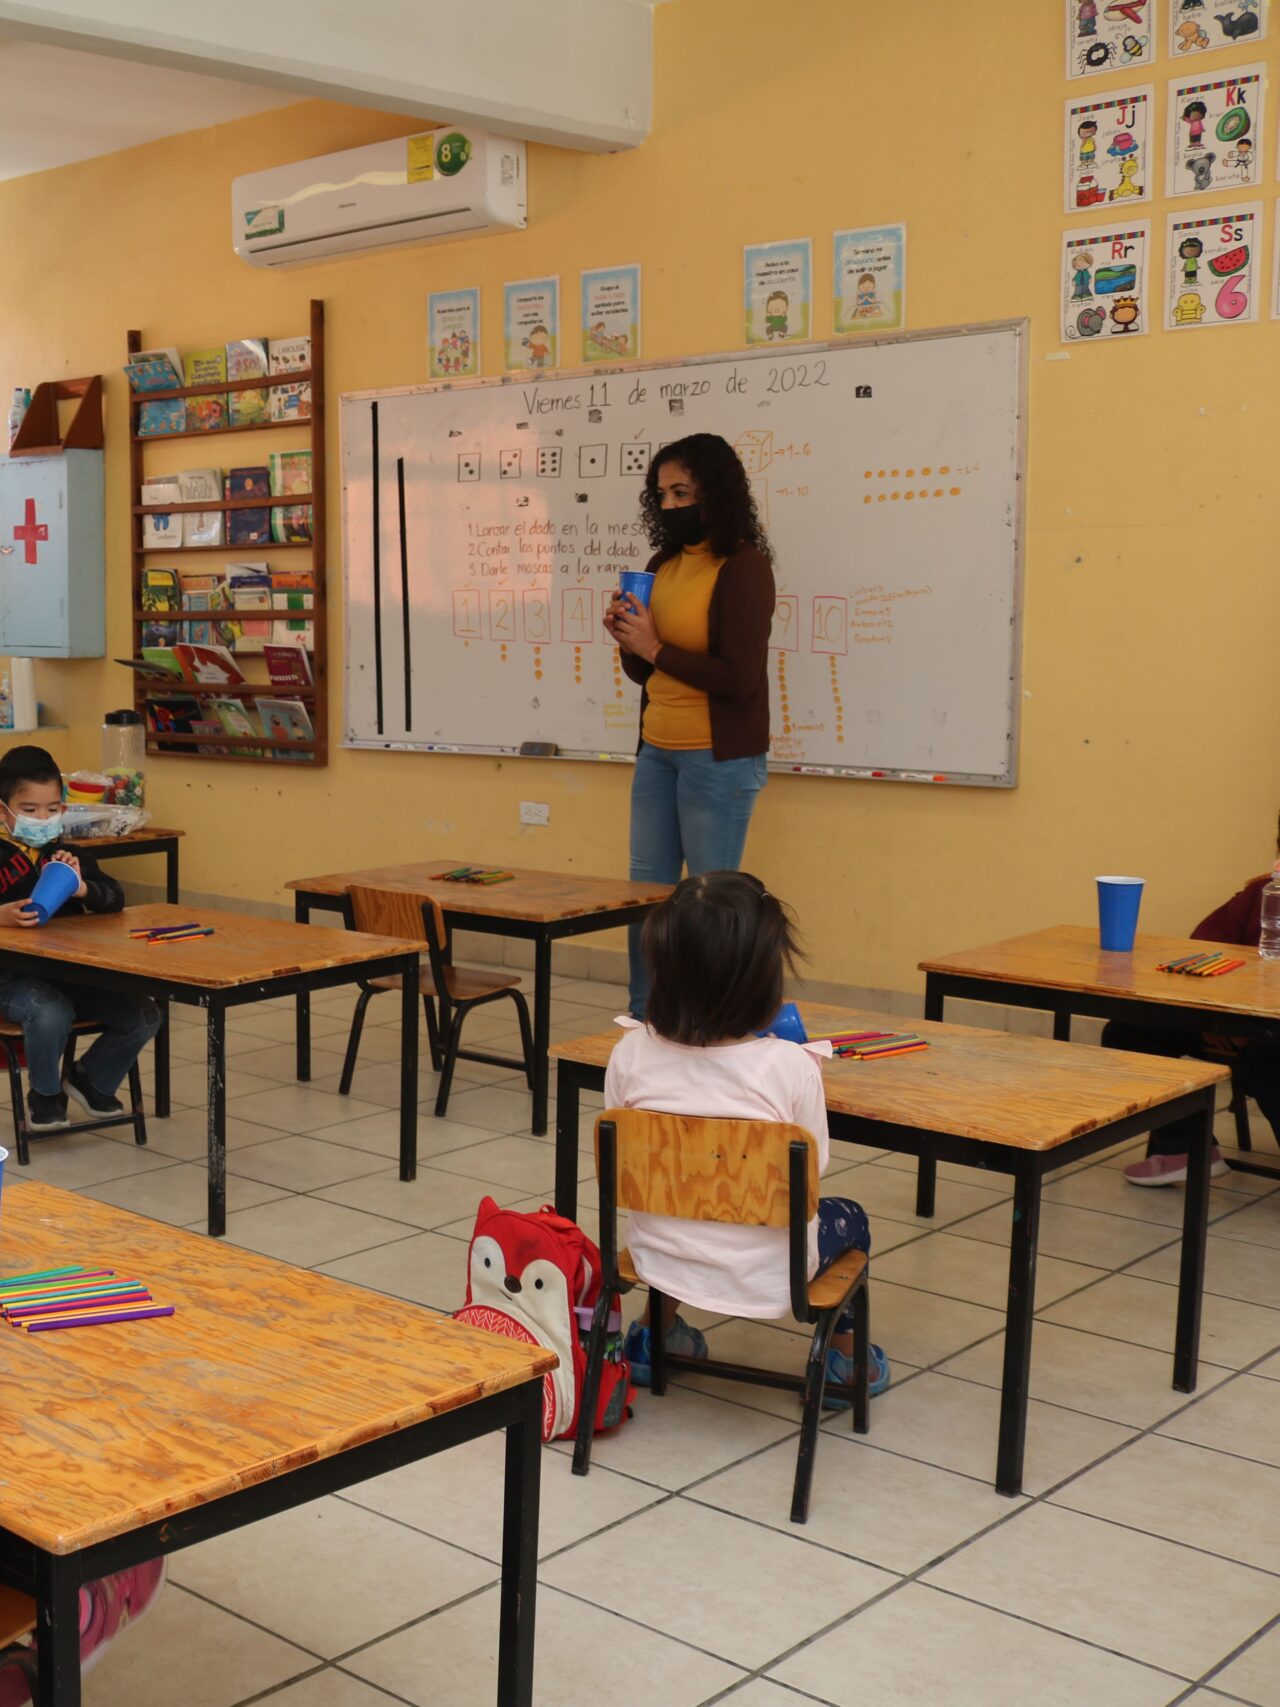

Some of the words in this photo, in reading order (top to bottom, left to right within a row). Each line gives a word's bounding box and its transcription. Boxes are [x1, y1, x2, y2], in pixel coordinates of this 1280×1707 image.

[1226, 86, 1247, 107] Kk
[1116, 105, 1136, 129] Jj
[441, 143, 452, 163] 8
[1215, 173, 1241, 182] karate
[1219, 223, 1244, 244] Ss
[1111, 241, 1136, 261] Rr
[523, 389, 582, 416] Viernes
[587, 381, 613, 408] 11
[628, 379, 648, 406] de
[660, 379, 712, 400] marzo
[725, 367, 748, 395] de
[765, 360, 831, 394] 2022
[514, 520, 526, 537] el
[529, 518, 556, 536] dado
[562, 523, 579, 537] en
[585, 514, 599, 536] la
[607, 523, 648, 537] mesa
[519, 537, 533, 554] los
[536, 539, 576, 560] puntos
[583, 538, 602, 557] del
[606, 539, 640, 558] dado
[516, 563, 554, 575] moscas
[559, 563, 570, 575] a
[577, 557, 591, 576] la
[458, 596, 478, 633] 1
[495, 598, 510, 631] 2
[528, 599, 547, 638] 3
[570, 594, 590, 633] 4
[775, 601, 793, 636] 9
[814, 602, 843, 644] 10
